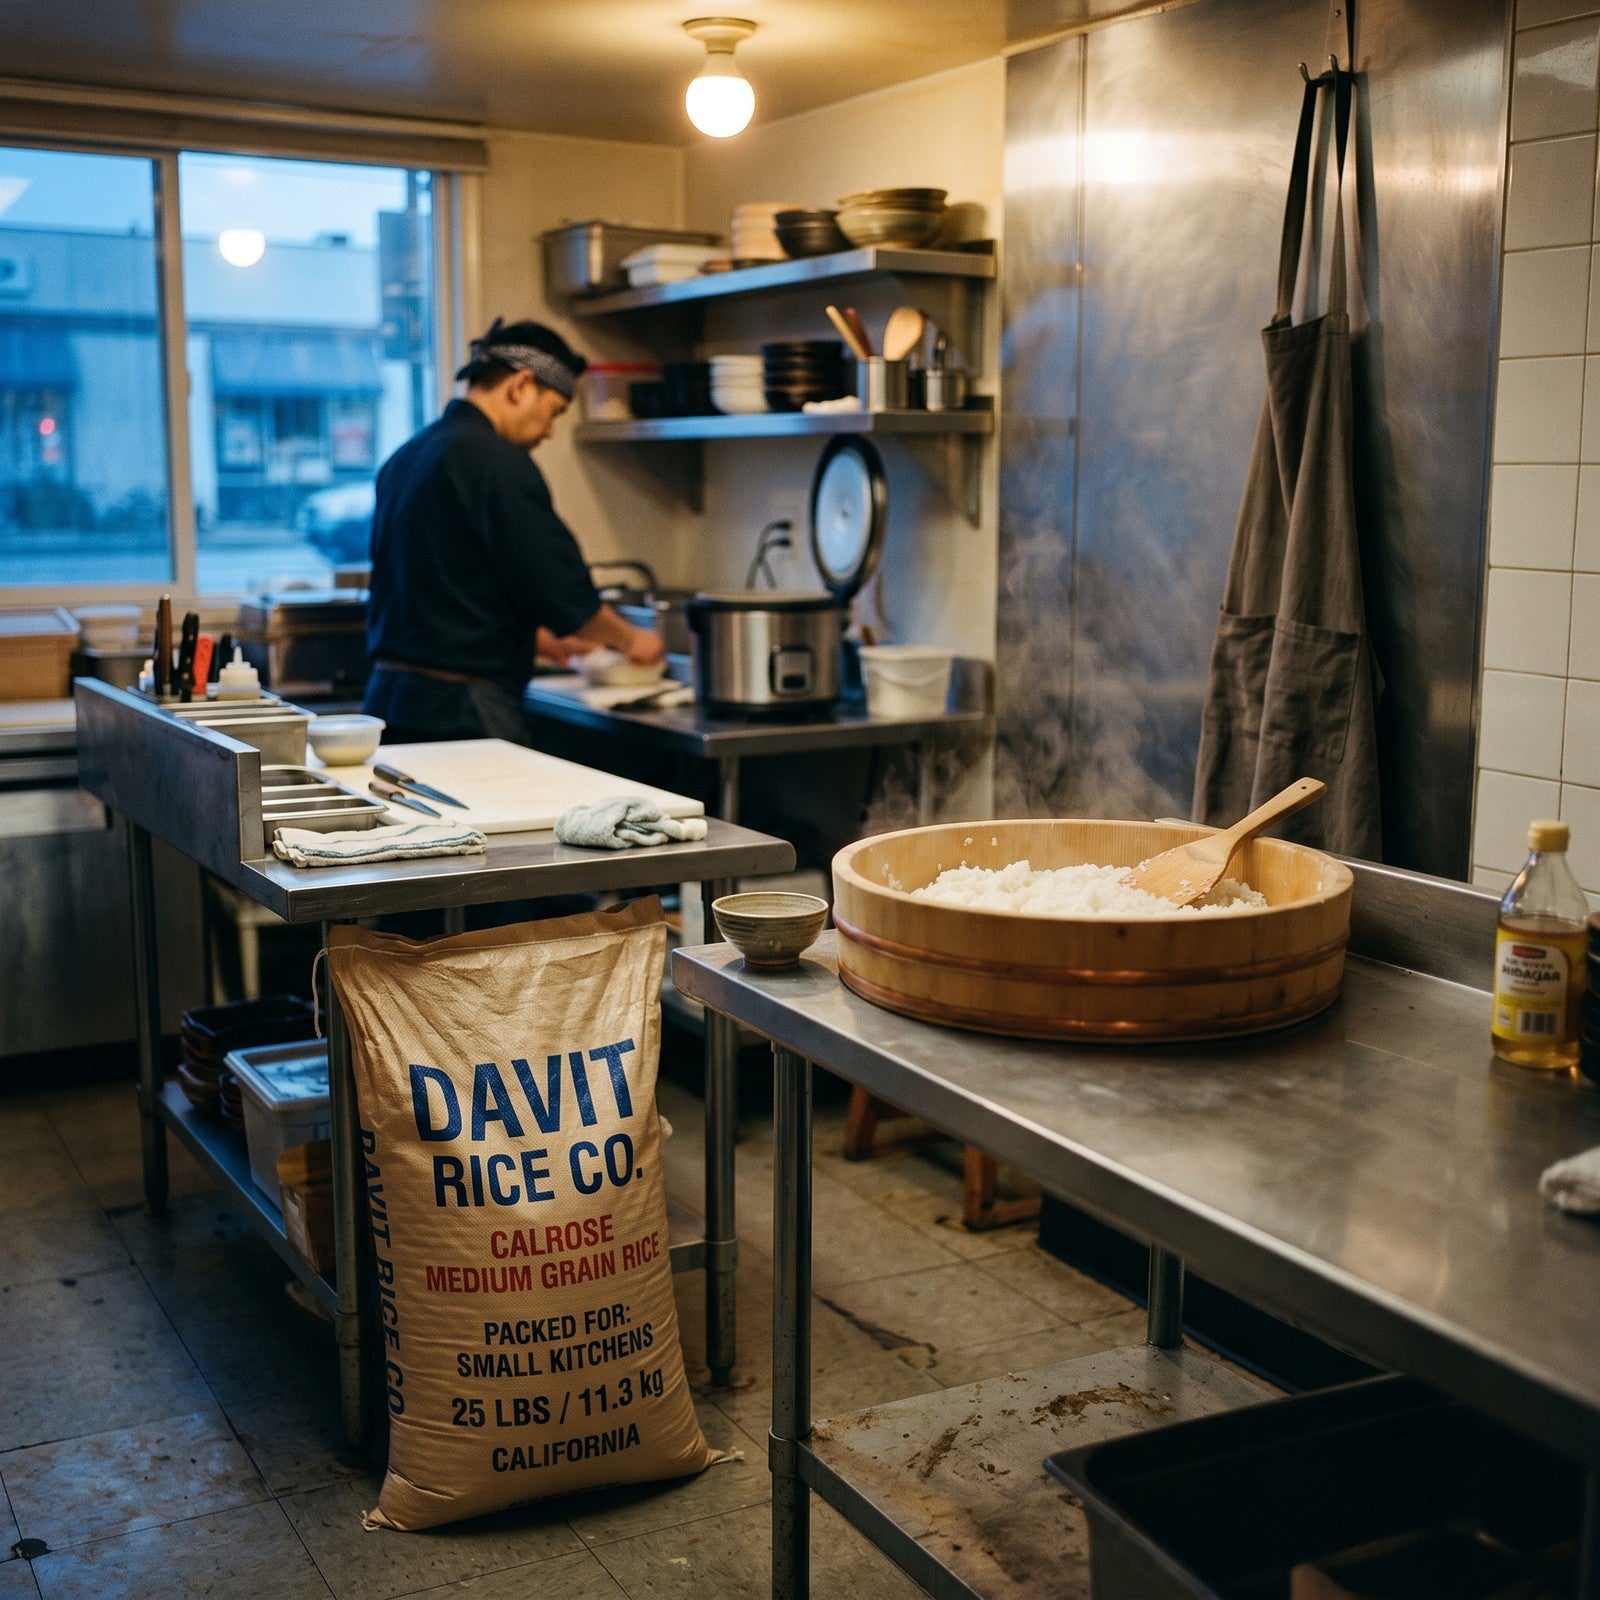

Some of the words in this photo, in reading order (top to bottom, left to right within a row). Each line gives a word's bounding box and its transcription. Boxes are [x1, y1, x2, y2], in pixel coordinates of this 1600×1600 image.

[409, 1038, 635, 1141] DAVIT
[433, 1148, 555, 1207] RICE
[569, 1133, 643, 1194] CO.
[360, 1128, 391, 1248] DAVIT
[376, 1254, 401, 1350] RICE
[426, 1265, 533, 1293] MEDIUM
[541, 1250, 616, 1289] GRAIN
[622, 1230, 660, 1271] RICE
[490, 1214, 615, 1259] CALROSE
[457, 1352, 543, 1377] SMALL
[550, 1322, 654, 1373] KITCHENS
[484, 1315, 576, 1345] PACKED
[584, 1303, 631, 1334] FOR:
[452, 1397, 486, 1427] 25
[496, 1396, 550, 1427] LBS
[559, 1391, 570, 1425] /
[579, 1377, 633, 1416] 11.3
[639, 1368, 664, 1397] kg
[492, 1423, 641, 1472] CALIFORNIA
